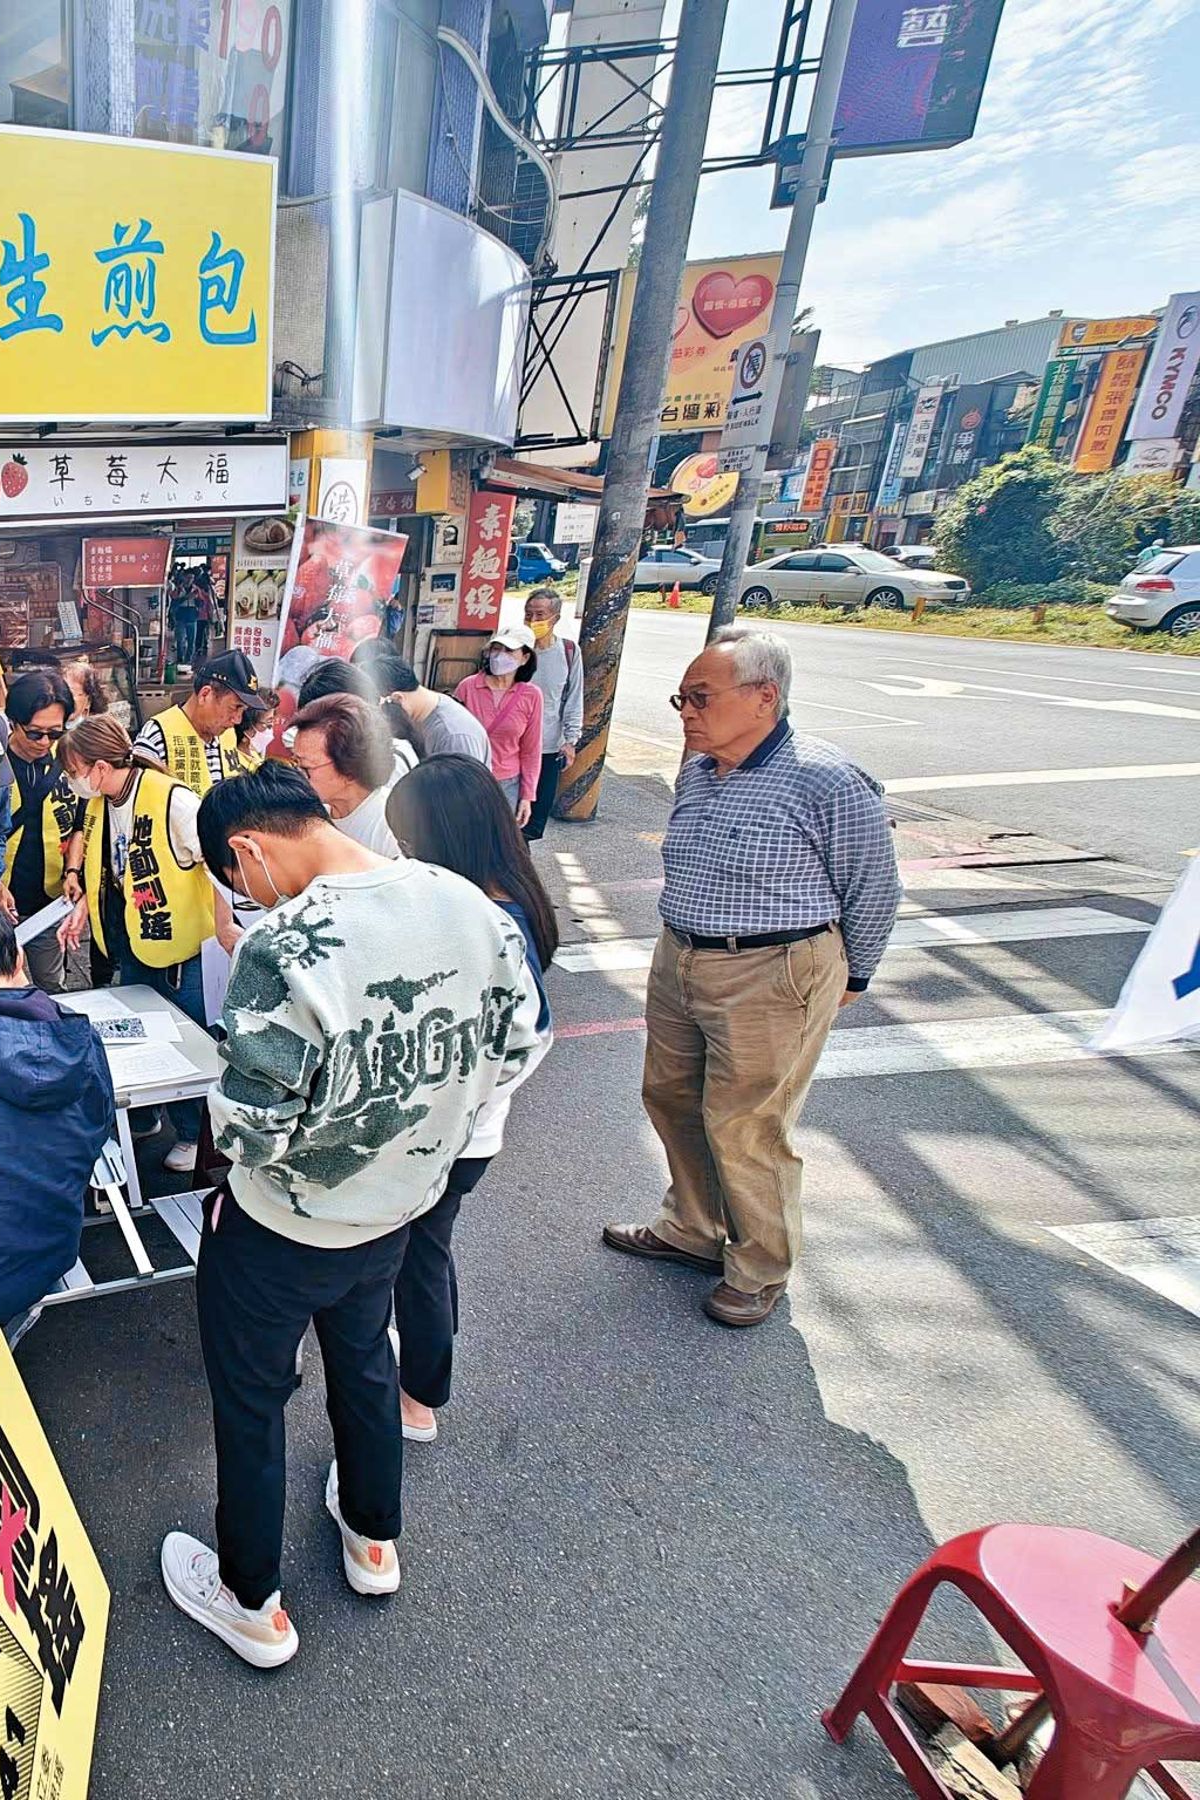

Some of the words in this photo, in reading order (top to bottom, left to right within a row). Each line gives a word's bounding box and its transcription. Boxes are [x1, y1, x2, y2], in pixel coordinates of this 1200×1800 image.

[1152, 346, 1188, 421] KYMCO
[661, 401, 730, 422] 台灣彩
[48, 453, 230, 491] 草莓大福
[53, 489, 230, 508] いちごだいふく
